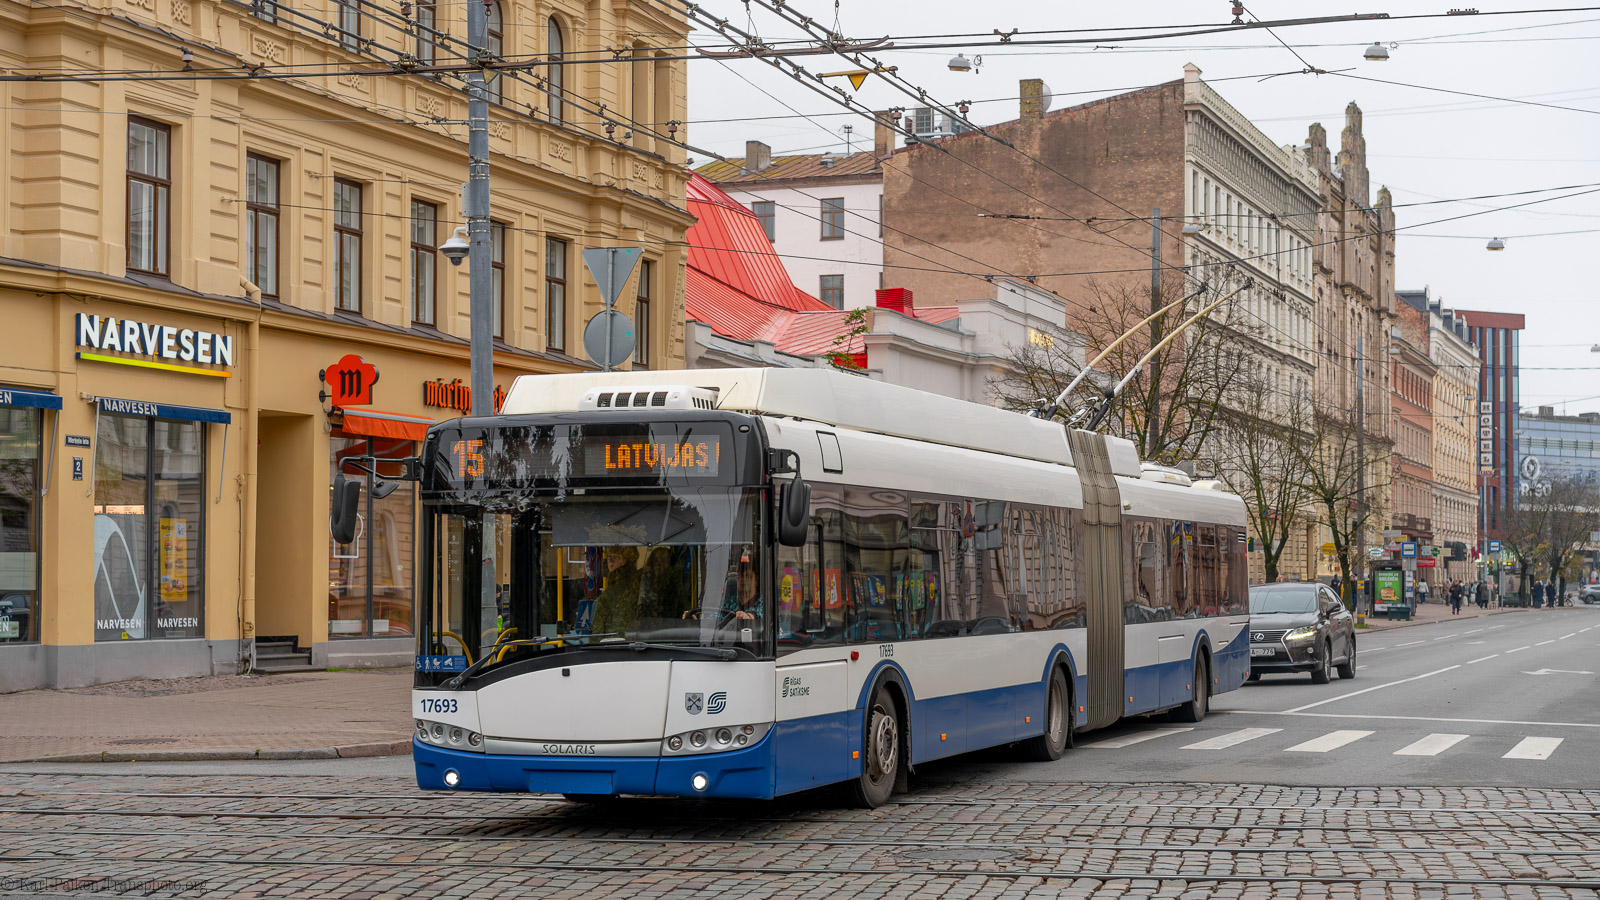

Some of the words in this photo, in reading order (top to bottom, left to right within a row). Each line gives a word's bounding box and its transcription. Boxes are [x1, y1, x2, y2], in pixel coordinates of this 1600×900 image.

[76, 313, 233, 366] NARVESEN
[103, 399, 158, 416] NARVESEN
[1482, 403, 1491, 464] HOTEL
[453, 440, 485, 477] 15
[605, 442, 709, 469] LATVIJAS
[75, 461, 81, 471] 2
[97, 618, 142, 630] NARVESEN
[157, 617, 199, 628] NARVESEN
[879, 644, 894, 658] 17693
[420, 698, 458, 713] 17693
[542, 744, 596, 755] SOLARIS
